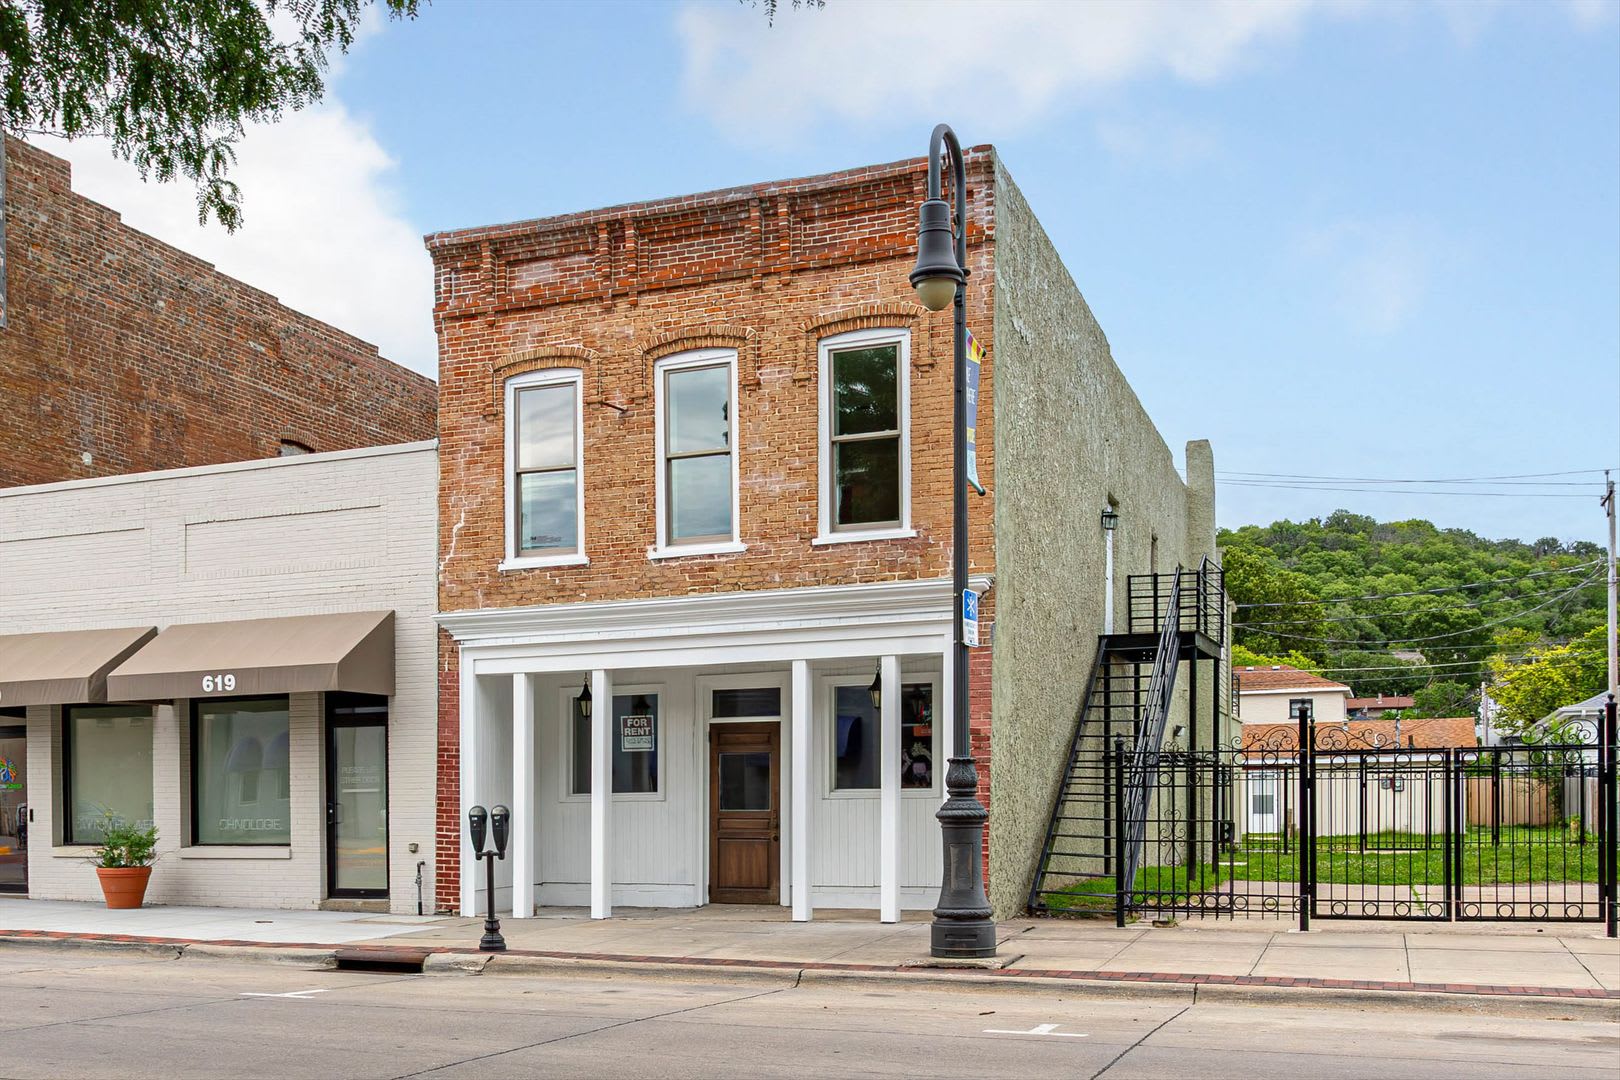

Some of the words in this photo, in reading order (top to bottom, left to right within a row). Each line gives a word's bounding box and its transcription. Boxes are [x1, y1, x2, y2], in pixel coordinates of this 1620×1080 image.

[202, 674, 236, 692] 619
[627, 718, 647, 727] FOR
[624, 727, 650, 736] RENT
